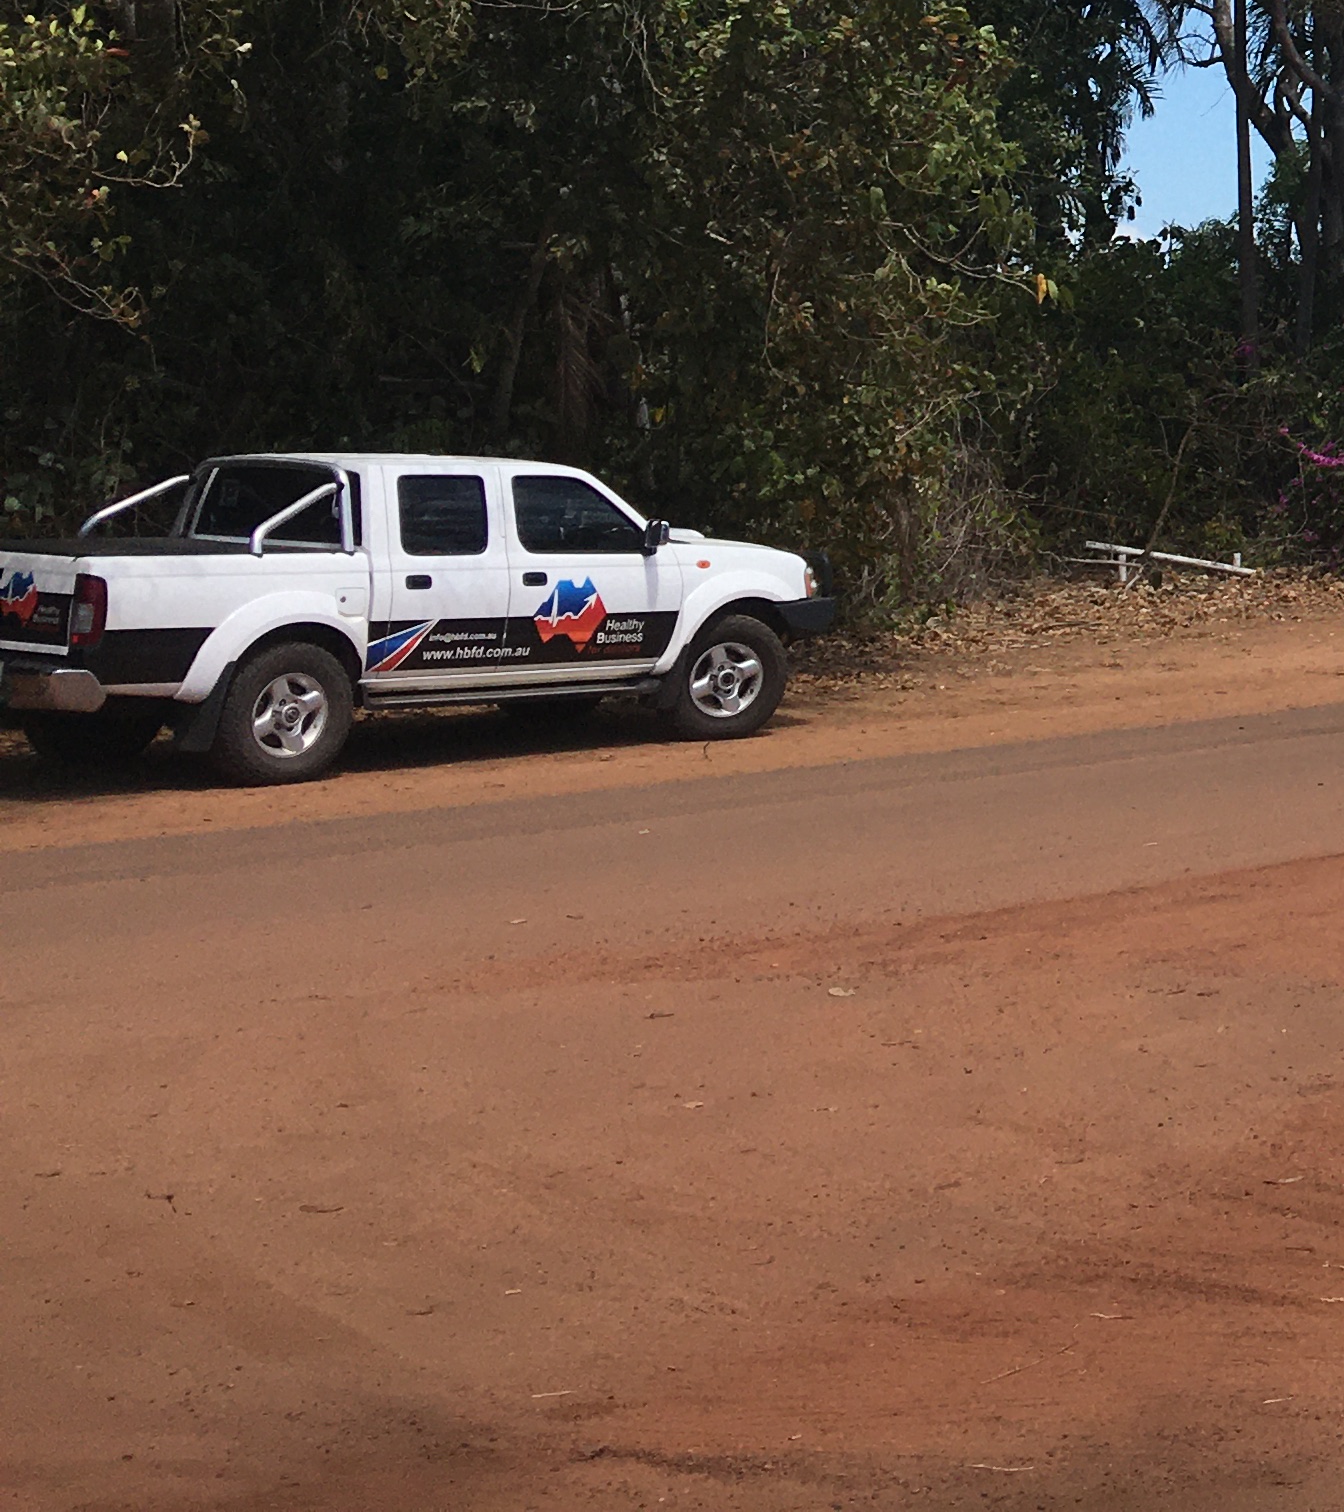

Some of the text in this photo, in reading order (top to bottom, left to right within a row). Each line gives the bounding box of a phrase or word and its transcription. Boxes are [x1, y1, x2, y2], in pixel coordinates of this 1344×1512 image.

[605, 619, 645, 632] Healthy
[596, 632, 643, 644] Business
[422, 646, 531, 660] www.hbfd.com.au
